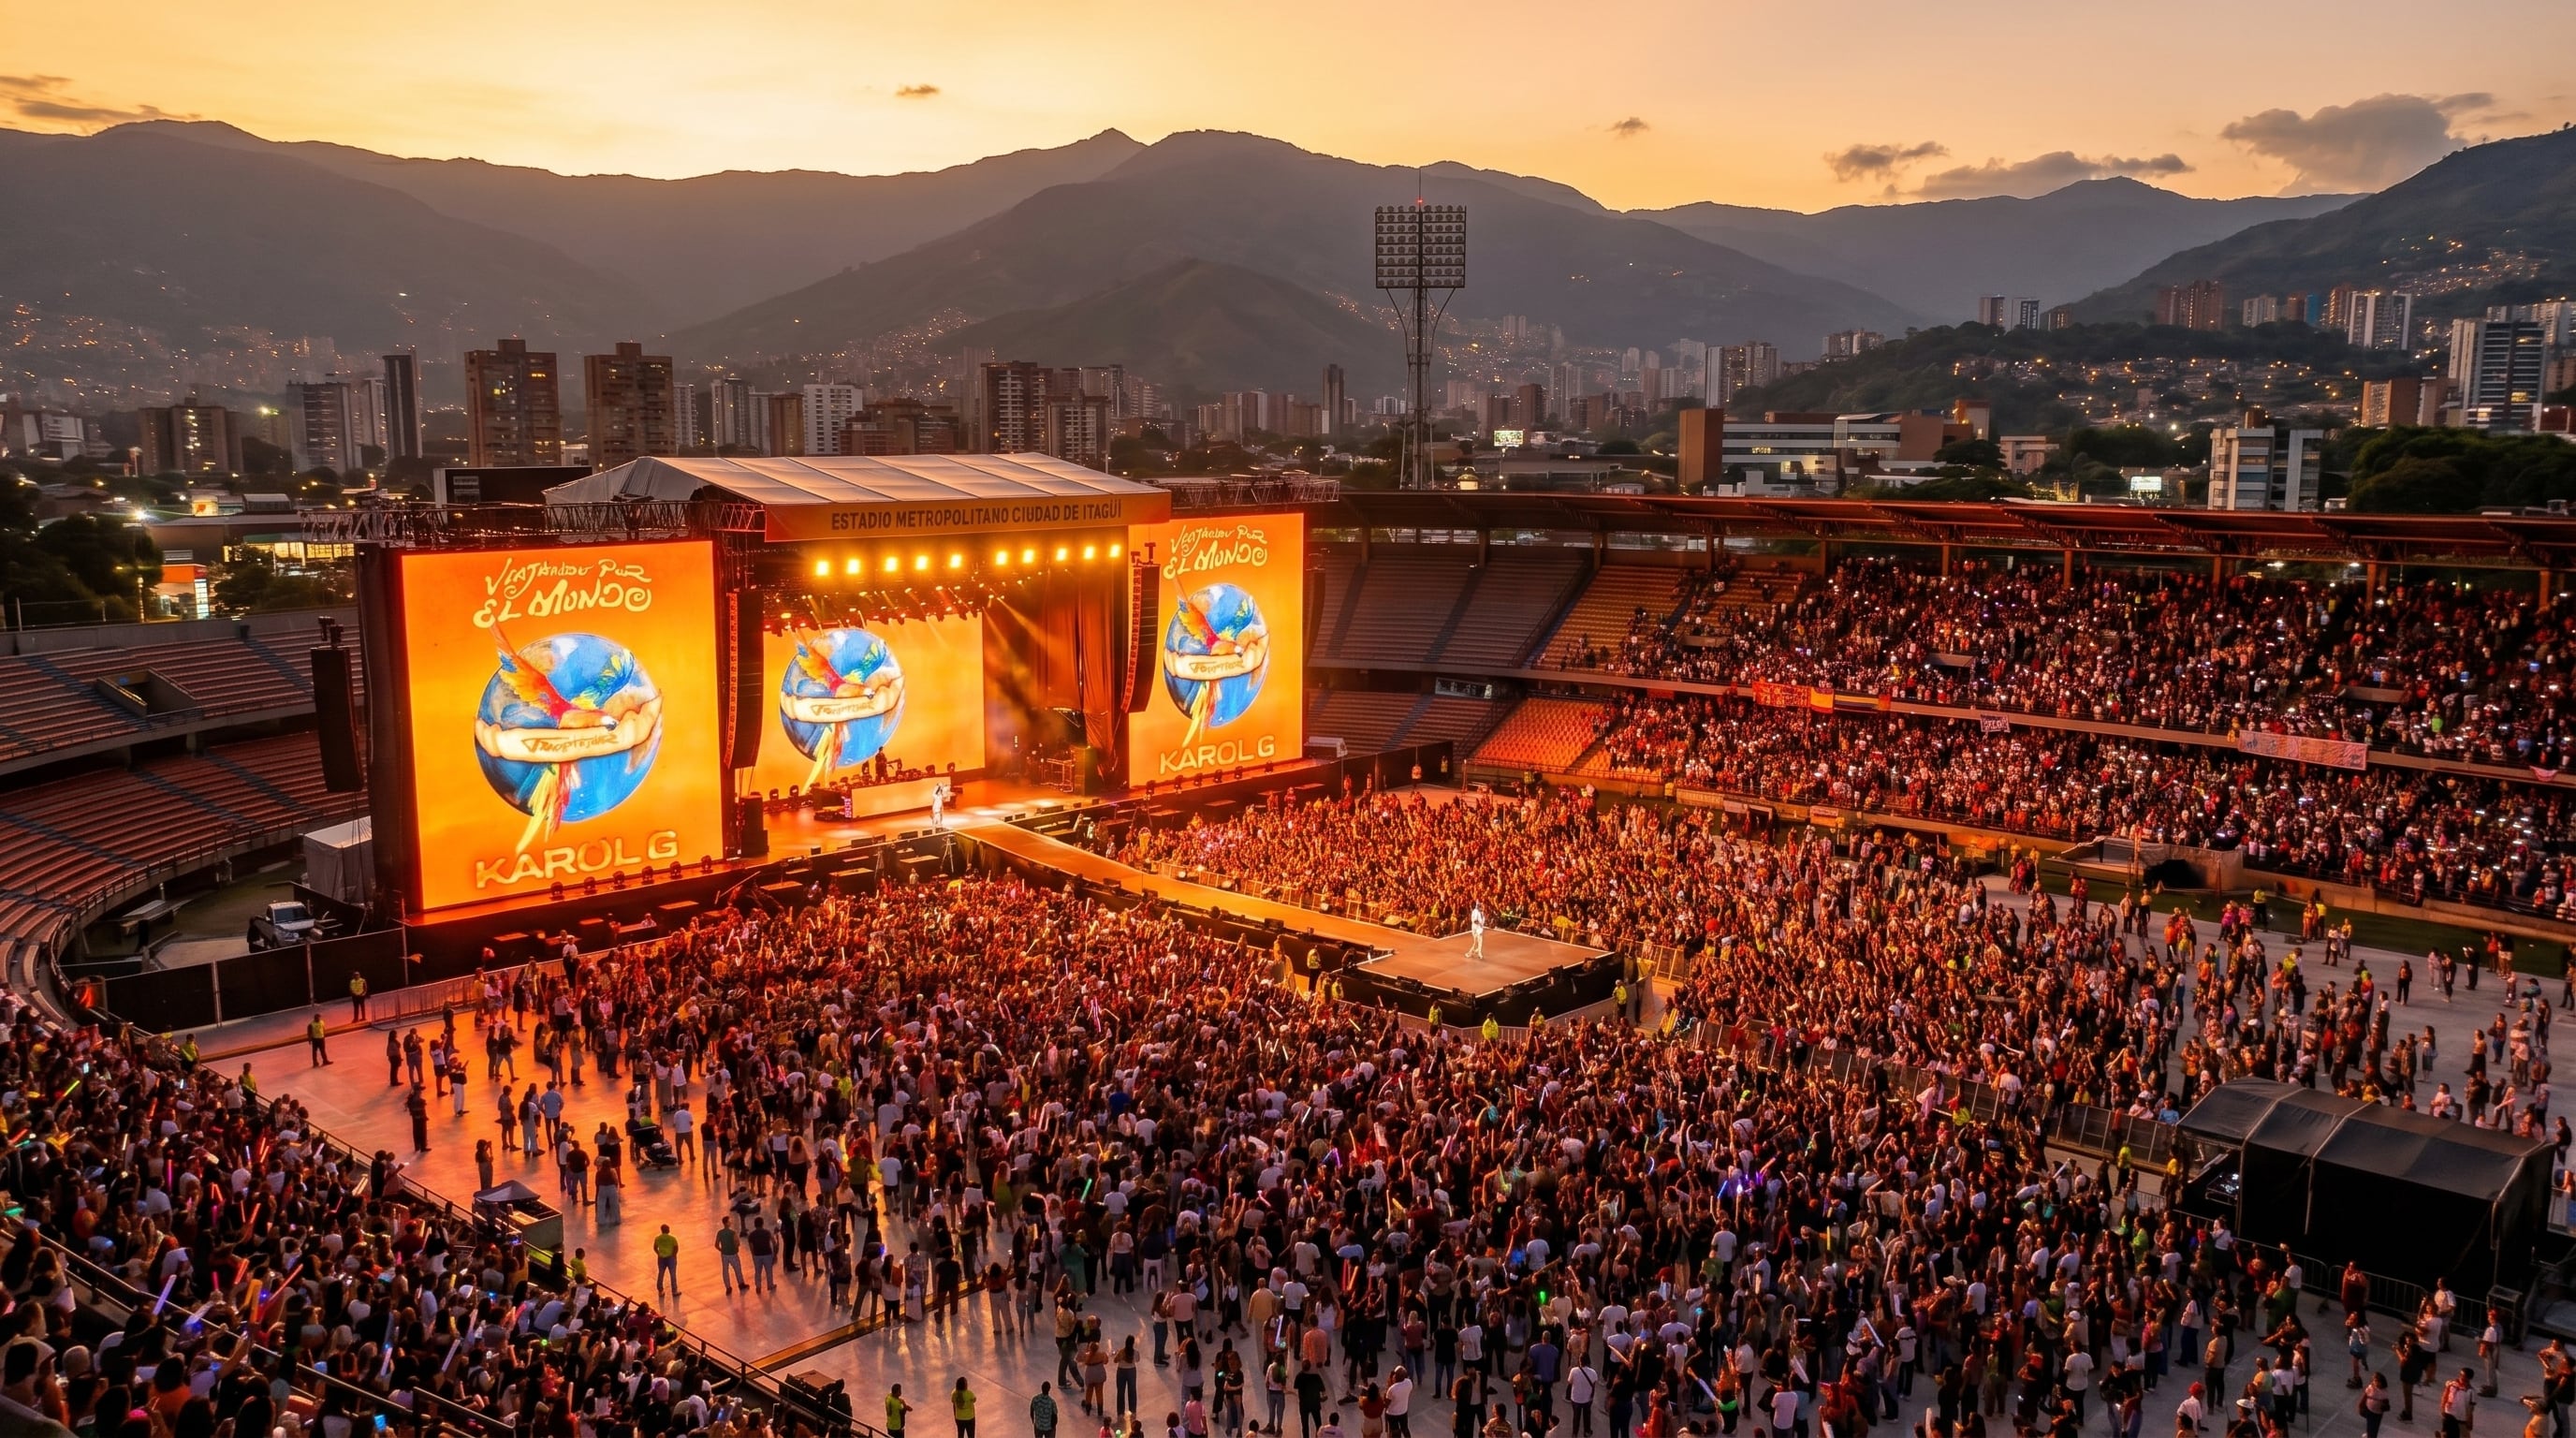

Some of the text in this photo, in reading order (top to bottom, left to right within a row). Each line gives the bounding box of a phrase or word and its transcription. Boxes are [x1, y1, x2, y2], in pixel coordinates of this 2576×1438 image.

[831, 511, 892, 531] ESTADIO
[896, 507, 1009, 528] METROPOLITANO
[1012, 506, 1061, 522] CIUDAD
[1063, 505, 1079, 521] DE
[1163, 539, 1268, 580] EL MUNDO
[473, 579, 652, 629] EL MUNDO
[1160, 735, 1275, 775] KAROL G
[475, 830, 679, 888] KAROL G
